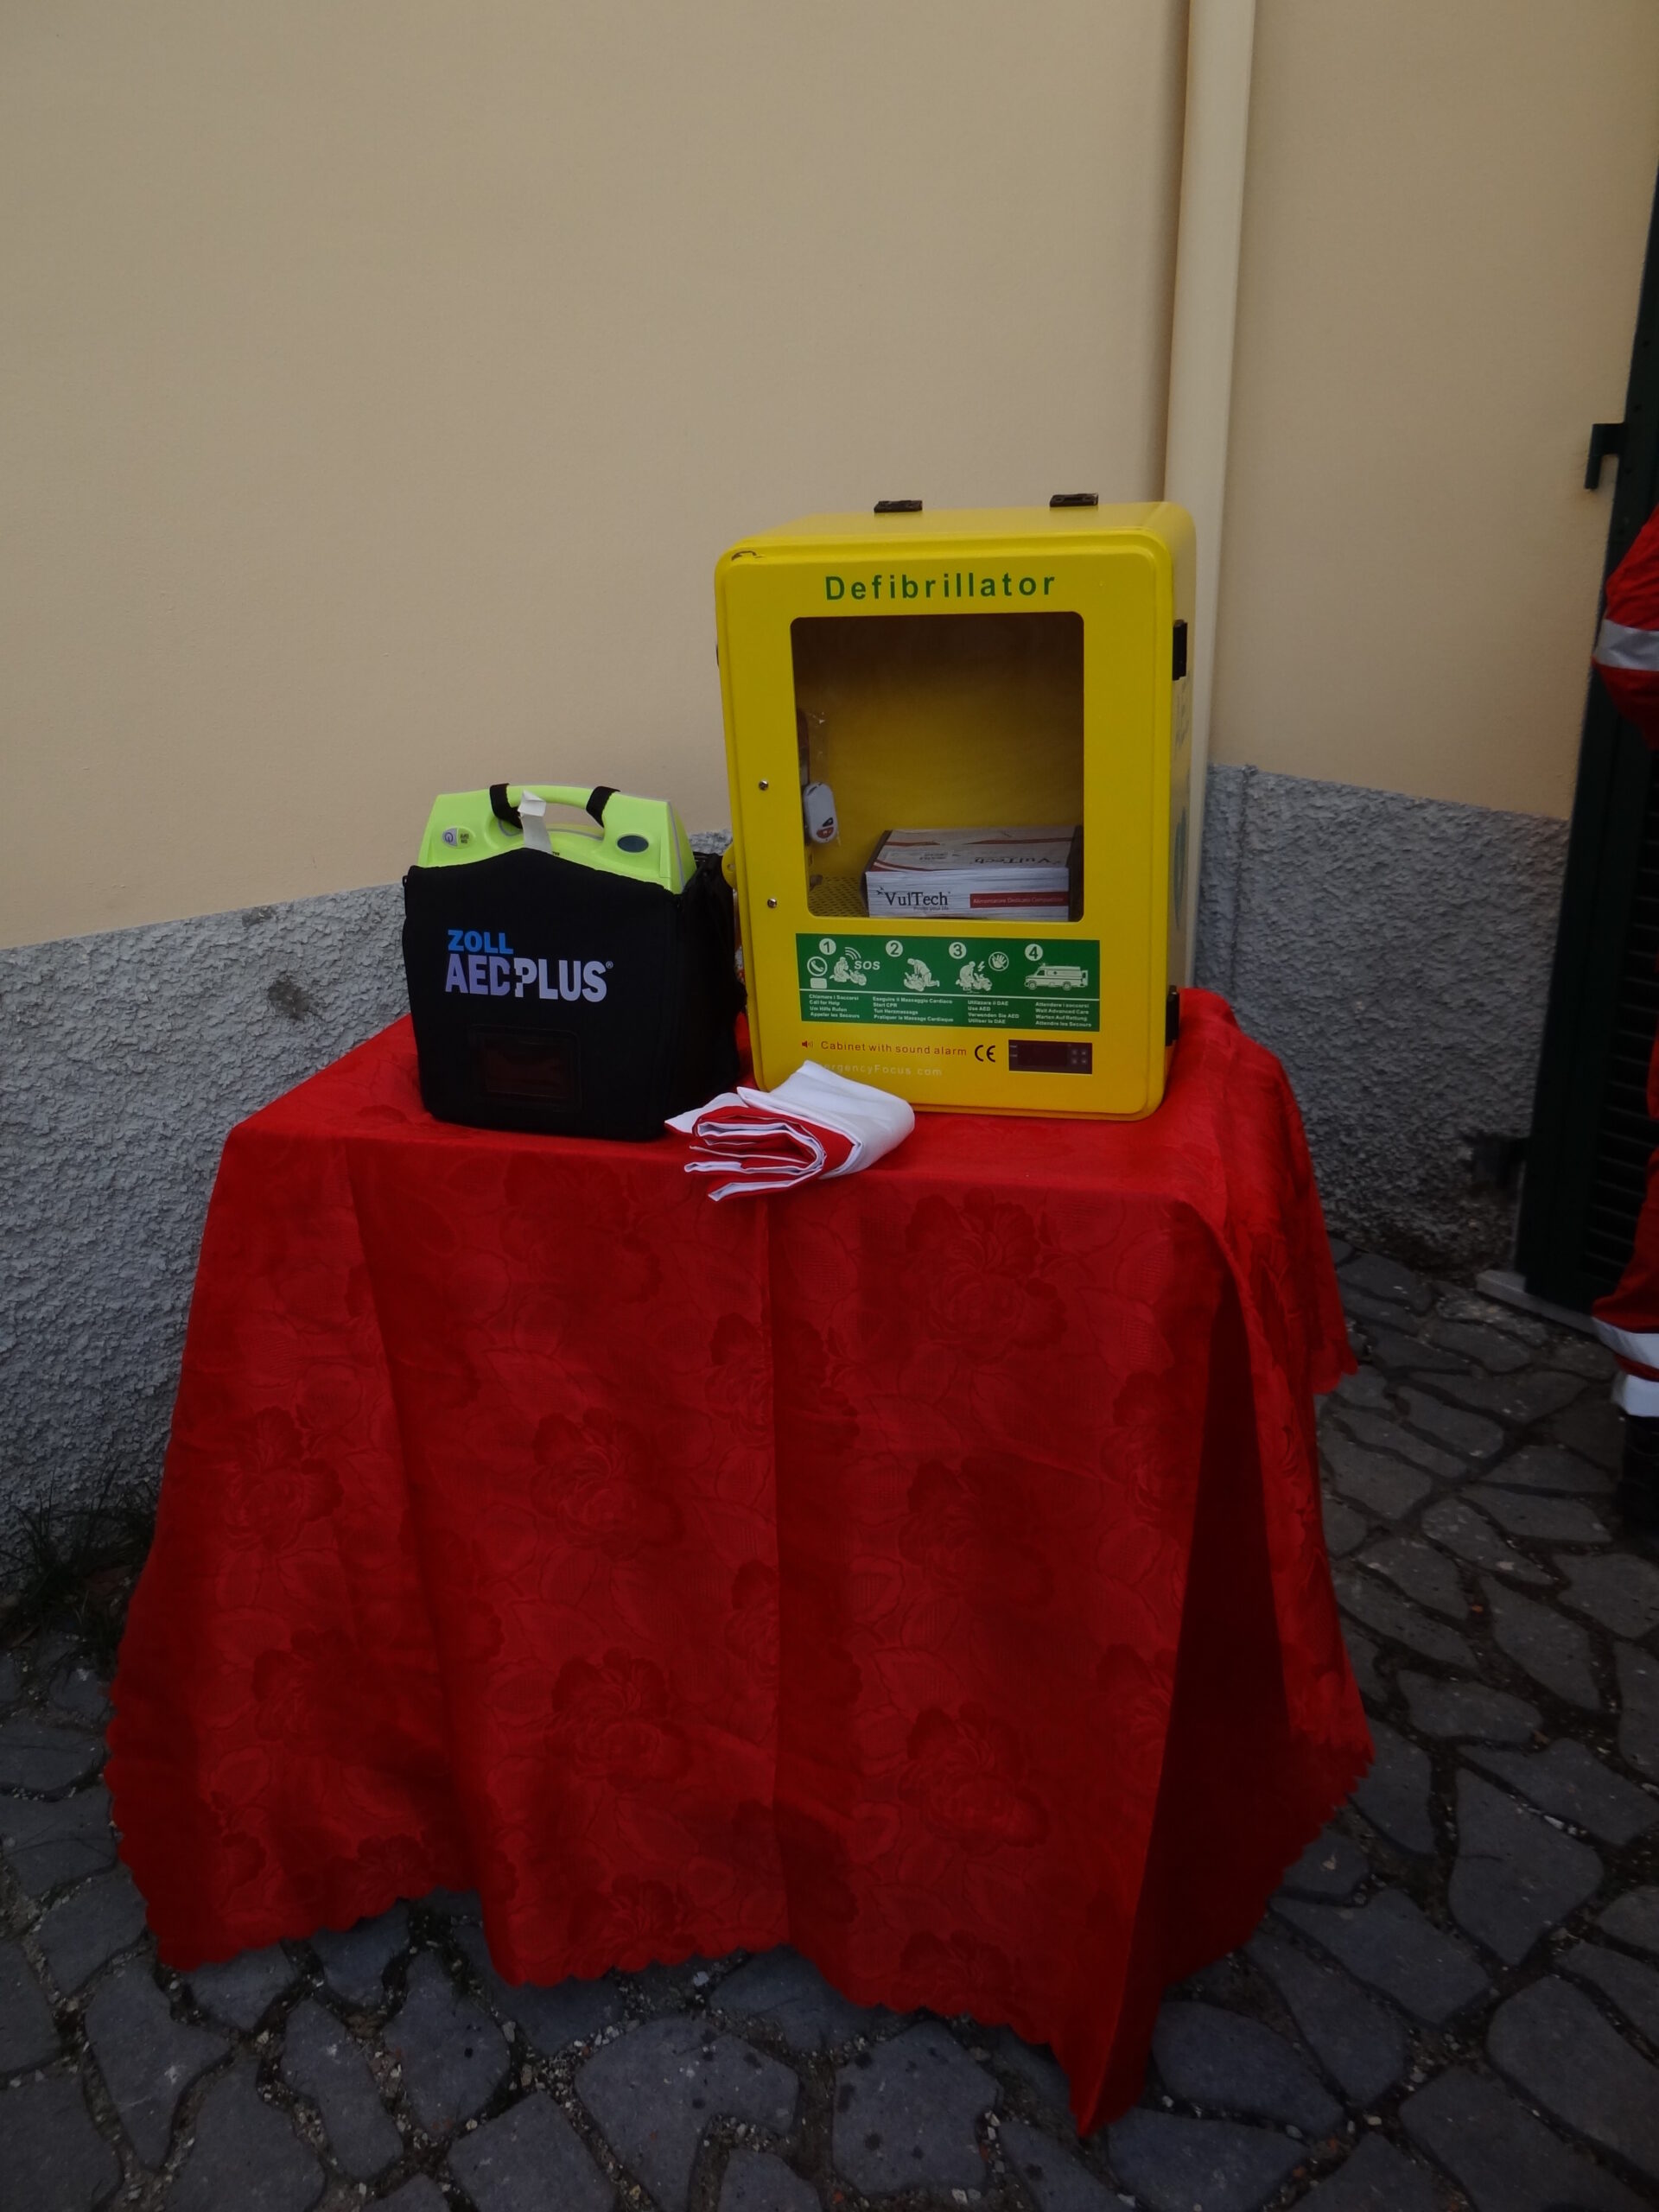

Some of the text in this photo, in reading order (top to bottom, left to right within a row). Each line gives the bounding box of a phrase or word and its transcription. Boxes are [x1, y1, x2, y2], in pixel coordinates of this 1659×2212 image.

[825, 572, 1055, 601] Defibrillator
[884, 891, 949, 906] VulTech
[448, 929, 514, 955] ZOLL
[823, 941, 830, 954] 1
[890, 942, 899, 955] 2
[953, 944, 963, 957] 3
[1028, 946, 1039, 960] 4
[854, 960, 880, 970] SOS
[820, 1040, 967, 1056] Cabinet with sound alarm
[975, 1044, 996, 1063] CE
